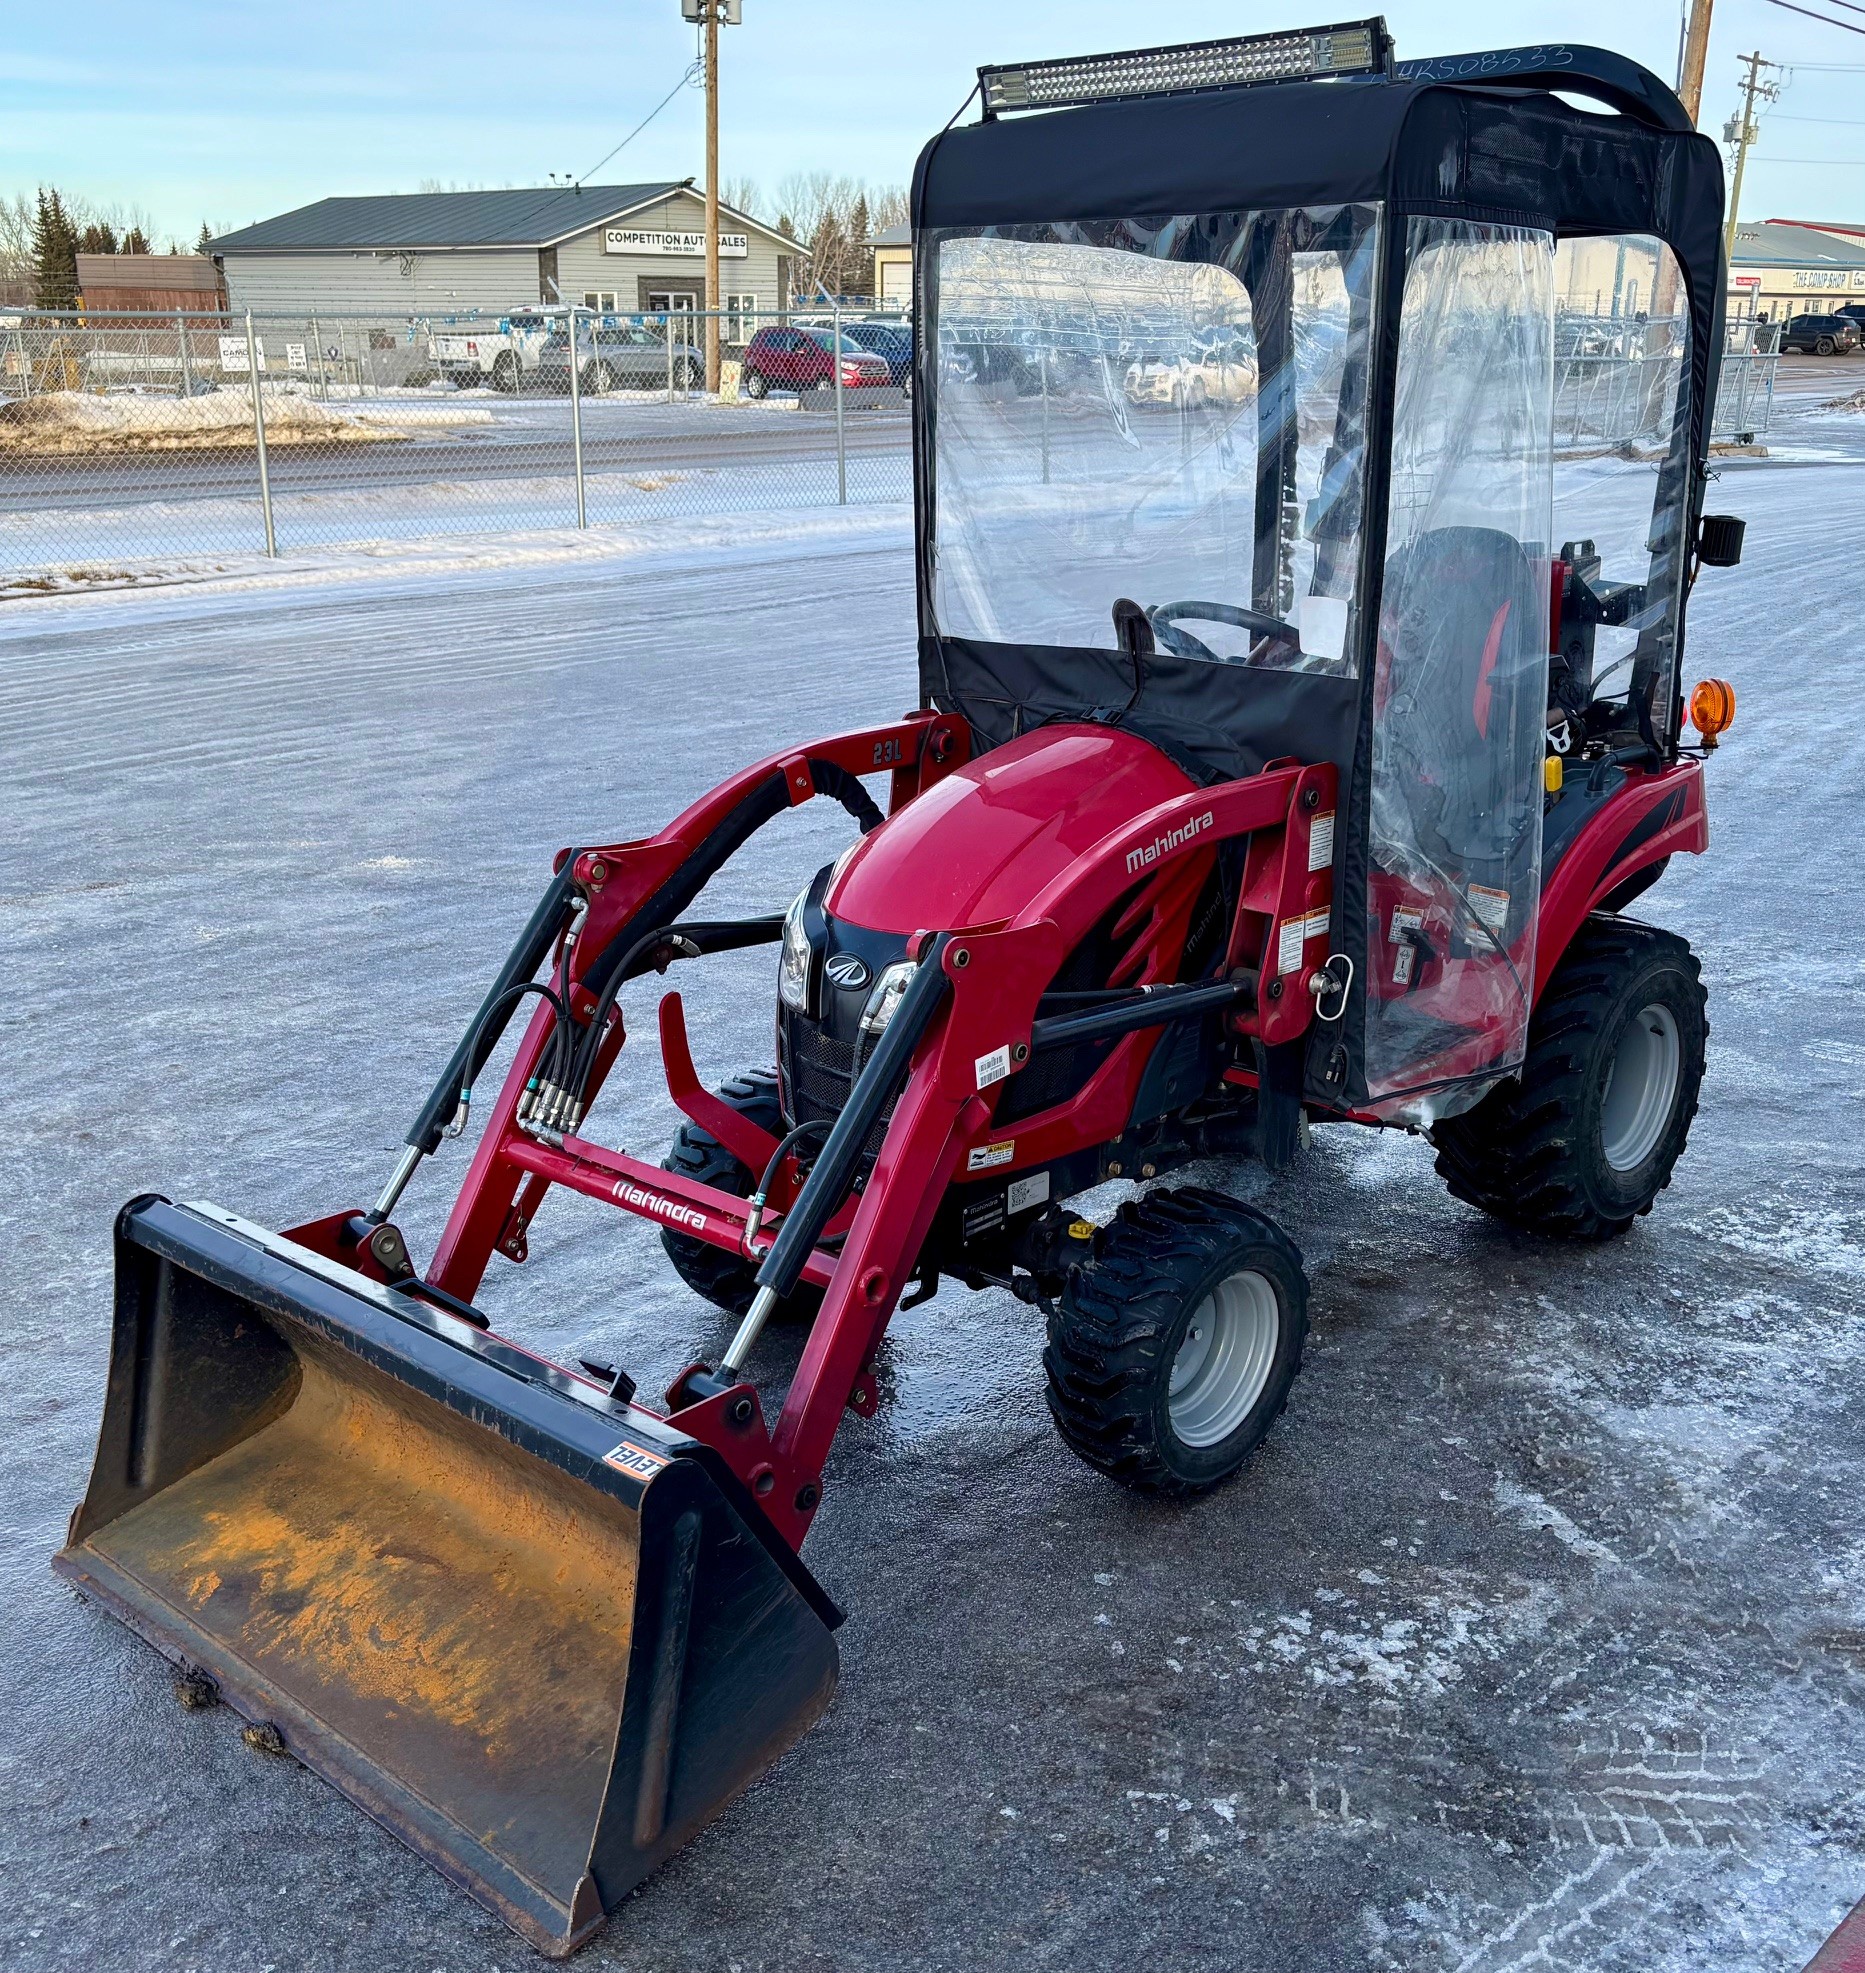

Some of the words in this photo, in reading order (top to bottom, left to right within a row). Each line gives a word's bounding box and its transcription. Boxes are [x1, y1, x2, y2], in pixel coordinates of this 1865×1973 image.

[607, 232, 681, 245] COMPETITION
[683, 235, 706, 246] AUT
[1795, 271, 1807, 287] THE
[1827, 273, 1846, 289] SHOP
[873, 739, 902, 764] 23L
[1126, 811, 1214, 874] Mahindra
[1186, 891, 1222, 953] Mahind
[612, 1179, 707, 1230] Mahindra
[610, 1446, 662, 1477] LEVEL
